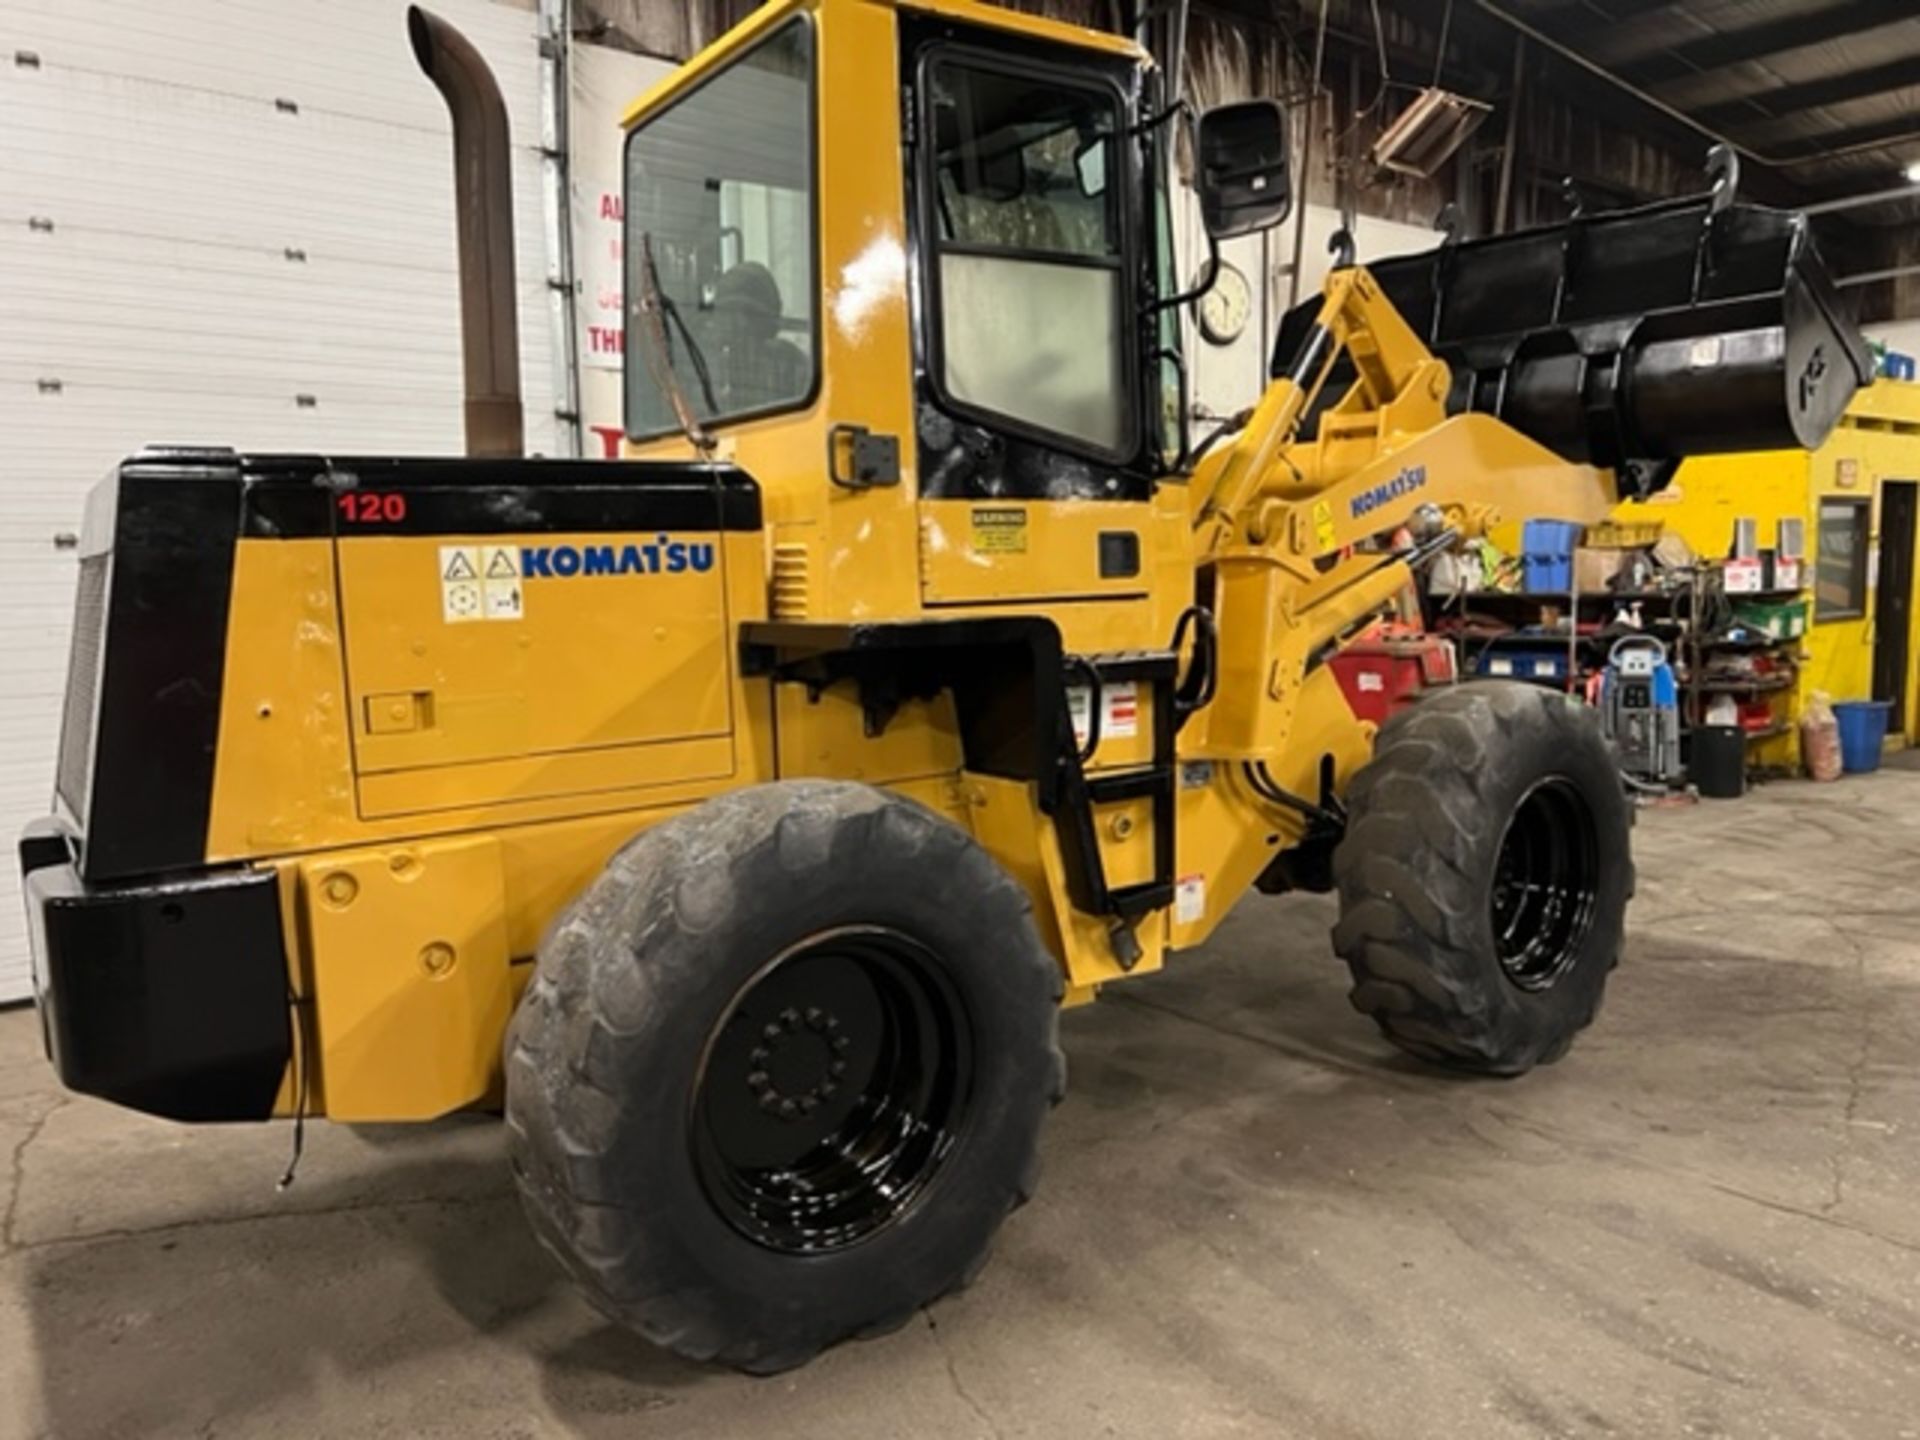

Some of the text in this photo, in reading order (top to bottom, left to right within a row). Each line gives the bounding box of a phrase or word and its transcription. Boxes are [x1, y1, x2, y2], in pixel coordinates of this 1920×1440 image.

[339, 495, 405, 522] 120
[1351, 466, 1425, 518] KOMATSU
[522, 535, 713, 577] KOMATSU
